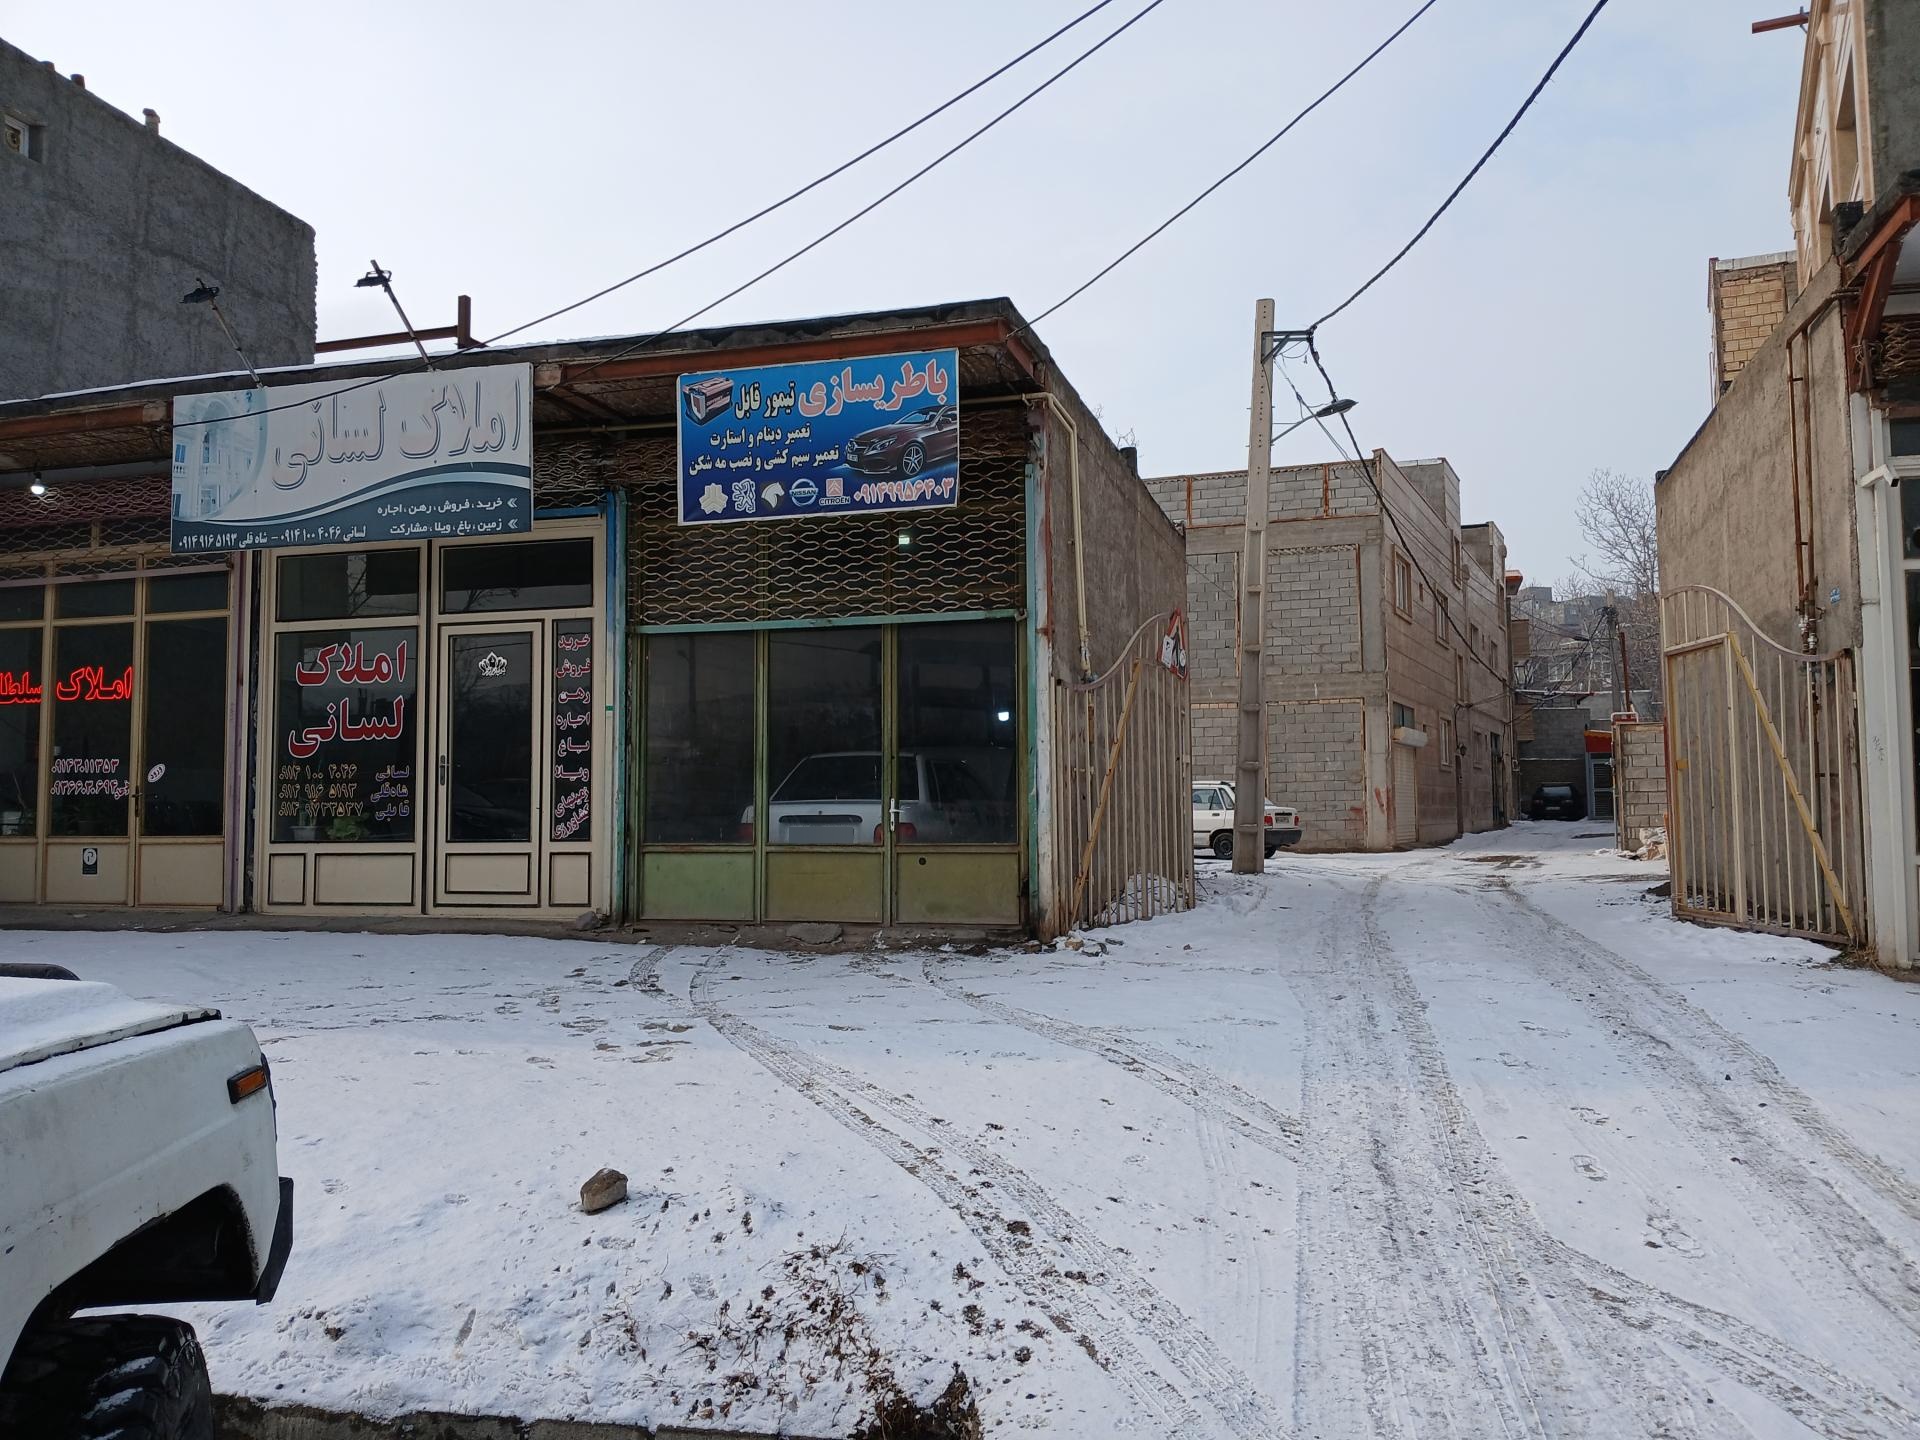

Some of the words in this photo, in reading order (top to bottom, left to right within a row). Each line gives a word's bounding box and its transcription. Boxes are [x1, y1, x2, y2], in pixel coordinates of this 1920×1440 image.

[798, 358, 948, 417] باطریسازی
[735, 384, 761, 420] قابل
[764, 381, 796, 418] تیمور
[399, 375, 522, 460] املاک
[271, 384, 387, 490] لسانی
[710, 427, 746, 450] استارت
[747, 432, 754, 448] و
[756, 425, 782, 447] دینام
[784, 423, 811, 445] تعمیر
[688, 453, 713, 476] شکن
[714, 457, 727, 470] مه
[729, 451, 753, 472] نصب
[754, 457, 762, 471] و
[764, 447, 789, 470] کشی
[791, 451, 810, 468] سیم
[812, 445, 840, 467] تعمیر
[790, 488, 817, 497] NISSAN
[853, 477, 955, 504] ۰۹۱۴۹۹۵۶۴۰۳
[377, 503, 403, 517] اجاره
[342, 525, 366, 542] لسانی
[390, 521, 428, 536] مشارکت
[558, 633, 590, 650] خرید
[295, 640, 408, 687] املاک
[555, 657, 592, 679] فروش
[56, 665, 134, 702] املاک
[557, 686, 590, 704] رهن
[288, 695, 405, 759] لسانی
[374, 764, 410, 782] لسانی
[554, 764, 590, 782] ویلا
